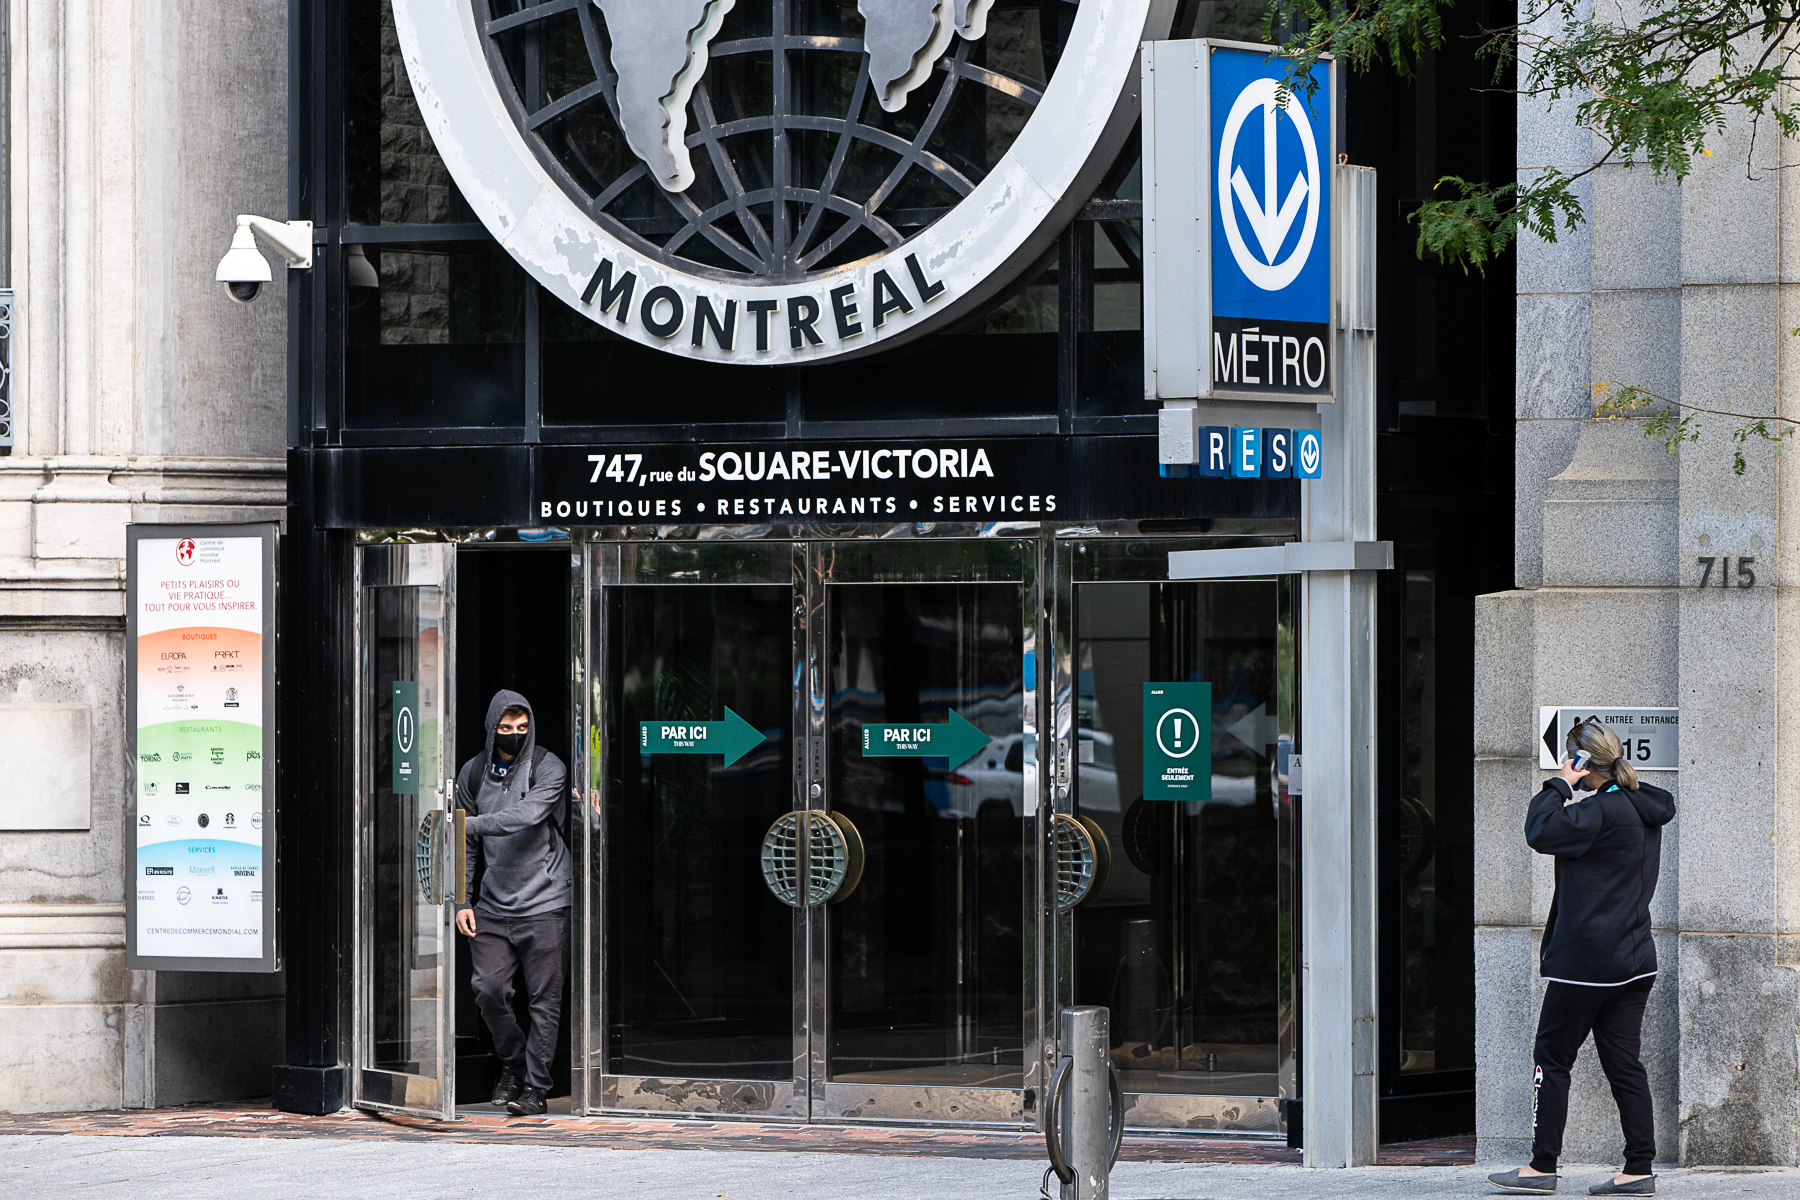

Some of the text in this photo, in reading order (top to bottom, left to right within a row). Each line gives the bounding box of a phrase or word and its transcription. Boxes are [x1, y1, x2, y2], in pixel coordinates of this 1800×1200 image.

[1213, 326, 1326, 388] MÉTRO
[587, 448, 995, 487] 747, rue du SQUARE-VICTORIA
[541, 495, 1057, 517] BOUTIQUES RESTAURANTS SERVICES
[1698, 556, 1756, 589] 715
[160, 579, 240, 589] PETITS PLAISIRS OU
[168, 591, 232, 600] VIE PRATIQUE...
[144, 601, 258, 612] TOUT POUR VOUS INSPIRER.
[1605, 714, 1680, 725] ENTRÉE ENTRANCE
[661, 726, 707, 740] PAR ICI
[883, 728, 931, 742] PAR ICI
[1166, 766, 1189, 774] ENTRÉE
